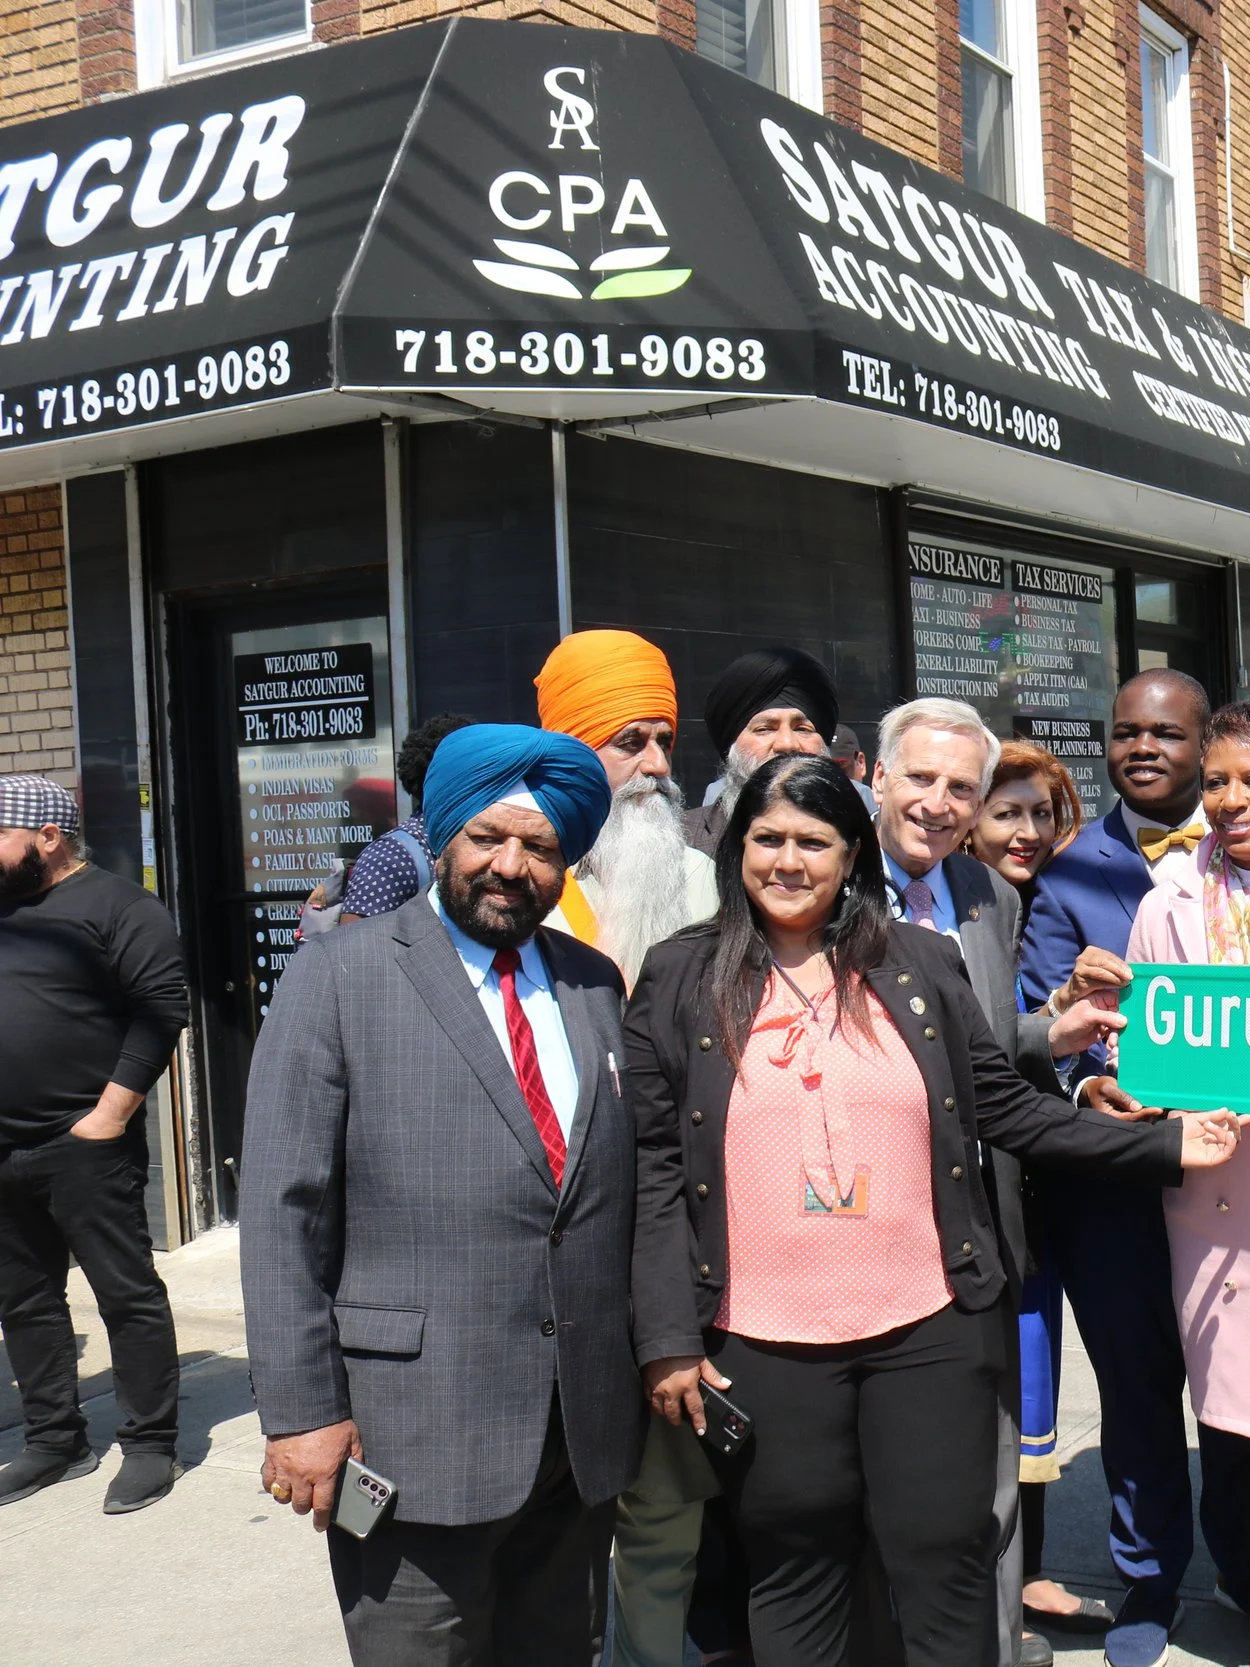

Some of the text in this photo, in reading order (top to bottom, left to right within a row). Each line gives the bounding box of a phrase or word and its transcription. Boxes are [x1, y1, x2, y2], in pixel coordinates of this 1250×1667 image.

[487, 170, 669, 237] CPA
[760, 117, 1055, 320] SATGUR
[1052, 261, 1161, 360] TAX
[1151, 307, 1199, 377] &
[0, 211, 296, 346] NTING
[798, 232, 1112, 400] ACCOUNTING
[1131, 369, 1246, 446] CERTIFIED
[395, 328, 766, 382] 718-301-9083
[37, 340, 291, 430] 718-301-9083
[842, 350, 1062, 452] TEL: 718-301-9083
[1016, 564, 1101, 600] TAX SERVICES
[941, 587, 967, 605] AUTO
[972, 591, 993, 609] LIFE
[1021, 594, 1078, 615] PERSONAL TAX
[912, 606, 981, 630] AXI BUSINESS
[1021, 614, 1076, 633] BUSINESS TAX
[1022, 632, 1102, 654] SALES TAX PAYROLL
[264, 651, 338, 675] WELCOME TO
[915, 653, 998, 676] ENERAL LIABILITY
[244, 674, 365, 702] SATGUR ACCOUNTING
[916, 676, 999, 698] ONSTRUCTION INS
[1023, 671, 1049, 687] APPLY
[1067, 675, 1088, 690] (CAA)
[1023, 691, 1070, 708] TAX AUDITS
[244, 706, 364, 741] Ph: 718-301-9083
[1031, 720, 1091, 737] NEW BUSINESS
[262, 747, 378, 772] IMMIGRATION FORMS
[1053, 740, 1088, 756] PLANNING
[1088, 741, 1103, 756] FOR:
[262, 777, 335, 797] INDIAN VISAS
[262, 800, 351, 823] OCI, PASSPORTS
[295, 828, 305, 845] &
[306, 826, 338, 845] MANY
[339, 825, 373, 844] MORE
[265, 853, 306, 871] FAMILY
[266, 877, 326, 892] CITIZENS
[270, 953, 293, 971] DIV
